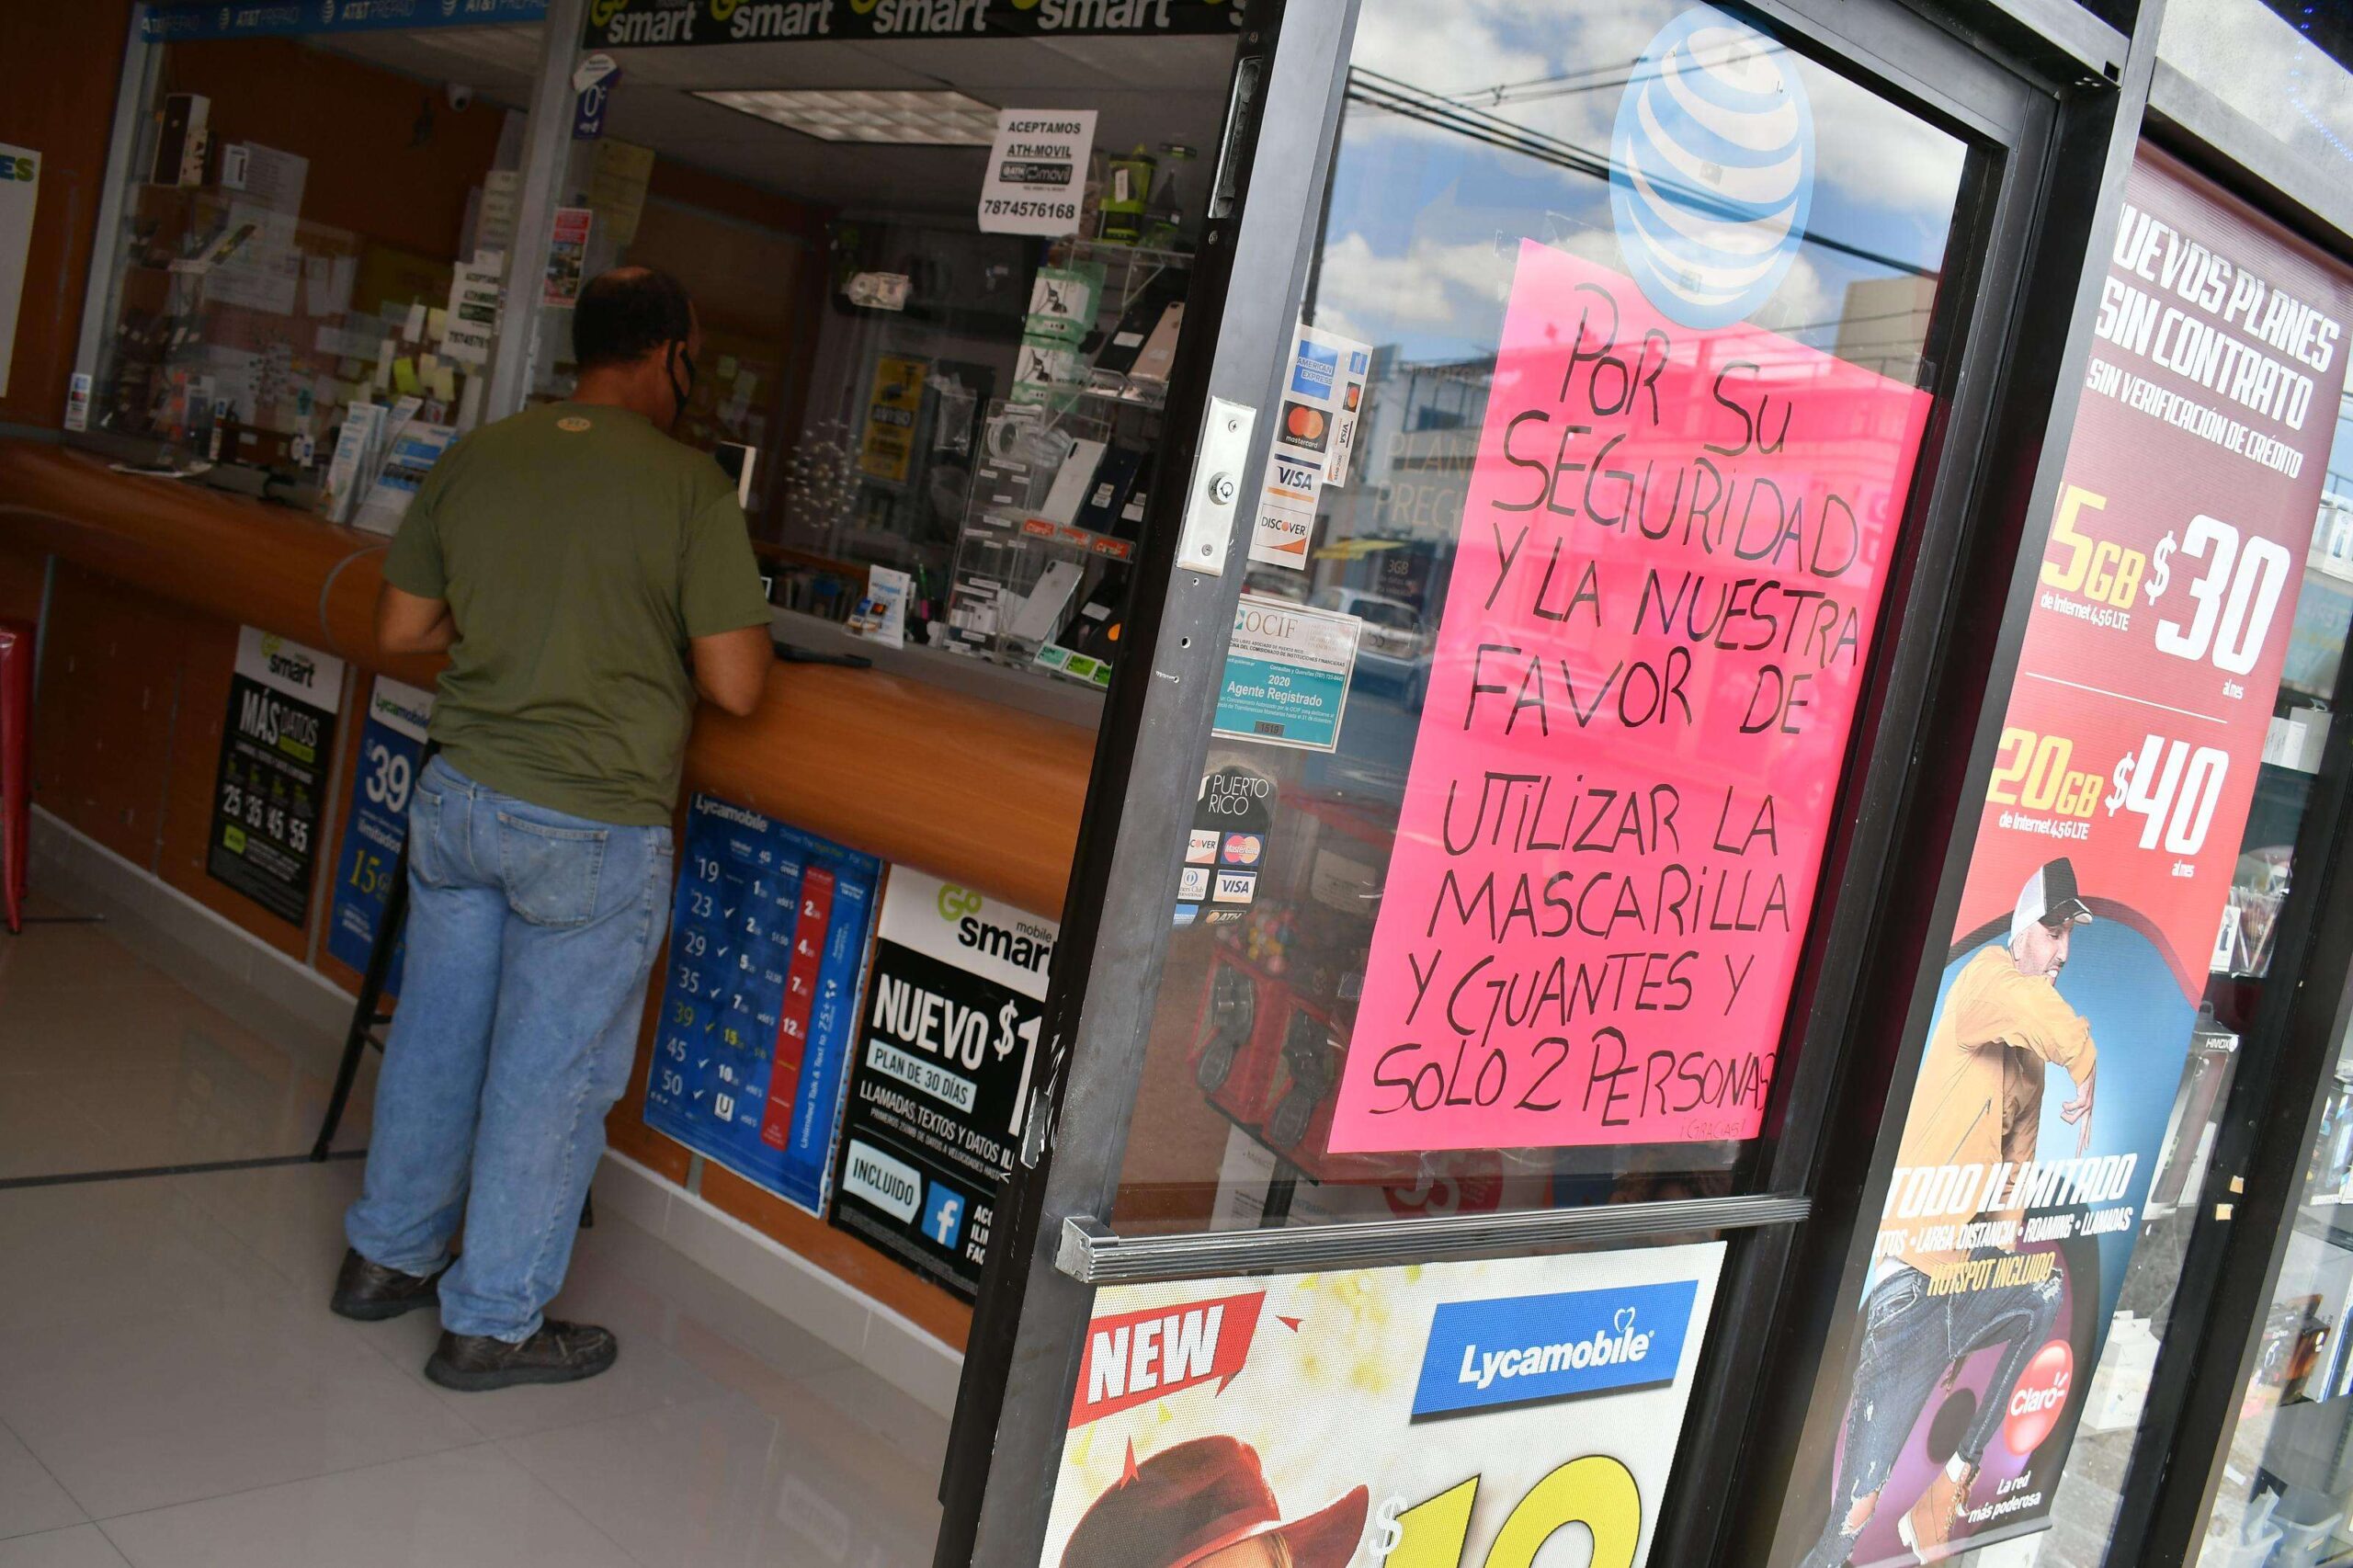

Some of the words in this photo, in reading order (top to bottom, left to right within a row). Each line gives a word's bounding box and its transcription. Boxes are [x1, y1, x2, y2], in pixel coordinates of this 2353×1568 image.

[608, 6, 697, 44] smart
[731, 0, 831, 39] smart
[872, 0, 987, 33] smart
[1037, 0, 1170, 29] smart
[1007, 121, 1082, 134] ACEPTAMOS
[1006, 144, 1072, 158] ATH-MOVIL
[983, 199, 1074, 220] 7874576168
[2113, 201, 2233, 314] UEVOS
[2223, 267, 2341, 373] PLANES
[1297, 357, 1333, 374] AMERICAN
[2094, 275, 2162, 357] SIN
[2152, 306, 2314, 432] CONTRATO
[1302, 370, 1333, 385] EXPRESS
[2086, 358, 2120, 398] SIN
[2120, 368, 2228, 446] VERIFICACIÓN
[2224, 418, 2249, 454] DE
[2245, 435, 2304, 480] CRÉDITO
[1286, 436, 1318, 449] mastercard
[1339, 424, 1349, 444] VISA
[1277, 465, 1313, 491] VISA
[1261, 516, 1306, 536] DISCOVER
[1388, 559, 1409, 576] 3GB
[1483, 521, 1529, 611] Y
[1532, 535, 1602, 629] LA
[1632, 567, 1859, 670] NUESTRA
[2144, 514, 2291, 676] $30
[1245, 610, 1299, 639] OCIF
[2040, 591, 2053, 610] de
[2053, 595, 2092, 622] Internet
[2111, 611, 2131, 631] LTE
[1250, 645, 1280, 656] COMISIONADO
[1287, 652, 1318, 663] INSTITUCIONES
[1318, 656, 1346, 667] FINANCIERAS
[1252, 640, 1272, 649] ASOCIADO
[268, 652, 315, 688] smart
[1267, 675, 1290, 687] 2020
[1269, 664, 1291, 674] Consultas
[1227, 681, 1266, 699] Agente
[1267, 687, 1323, 707] Registrado
[1463, 642, 1694, 738] FAVOR
[1739, 663, 1813, 735] DE
[2230, 684, 2244, 700] mes
[239, 686, 281, 746] MÁS
[278, 711, 321, 748] DATOS
[1290, 706, 1301, 714] OCIF
[1260, 723, 1279, 734] 1519
[1211, 774, 1269, 798] PUERTO
[2105, 733, 2230, 856] $40
[695, 793, 769, 834] Lycamobile
[1208, 793, 1249, 815] RICO
[1712, 783, 1779, 857] LA
[1998, 812, 2013, 828] de
[2013, 812, 2052, 834] Internet
[2072, 822, 2091, 840] LTE
[1225, 845, 1260, 856] MasterCard
[2181, 861, 2195, 879] mes
[938, 881, 982, 921] Go
[1221, 880, 1249, 893] VISA
[1217, 913, 1242, 922] ATH
[958, 916, 1054, 978] smar
[1016, 922, 1052, 943] mobile
[1405, 948, 1443, 1026] Y
[1446, 949, 1700, 1048] GUANTES
[1723, 953, 1755, 1016] Y
[872, 972, 990, 1072] NUEVO
[813, 1047, 825, 1068] Text
[808, 1080, 821, 1100] Talk
[874, 1048, 904, 1076] PLAN
[906, 1062, 921, 1085] DE
[925, 1070, 939, 1092] 30
[942, 1076, 969, 1106] DÍAS
[1513, 1037, 1570, 1113] 2
[1582, 1026, 1777, 1127] PERSONAS
[800, 1101, 815, 1149] Unlimited
[918, 1105, 957, 1142] TEXTOS
[958, 1125, 968, 1145] Y
[965, 1131, 1000, 1164] DATOS
[853, 1157, 915, 1206] INCLUIDO
[1881, 1163, 1978, 1221] TODO
[1977, 1153, 2138, 1214] ILIMITADO
[1915, 1224, 1956, 1254] LARGA
[1955, 1220, 2018, 1251] DISTANCIA
[2022, 1213, 2075, 1244] ROAMING
[2080, 1207, 2133, 1236] LLAMADAS
[1926, 1257, 1995, 1298] HOTSPOT
[1990, 1251, 2056, 1290] INCLUIDO
[1087, 1305, 1224, 1406] NEW
[1459, 1327, 1651, 1390] Lycamobile
[2009, 1388, 2058, 1416] Claro
[1995, 1478, 2012, 1495] La
[2011, 1471, 2030, 1494] red
[1967, 1502, 1994, 1525] más
[1993, 1491, 2041, 1521] poderosa
